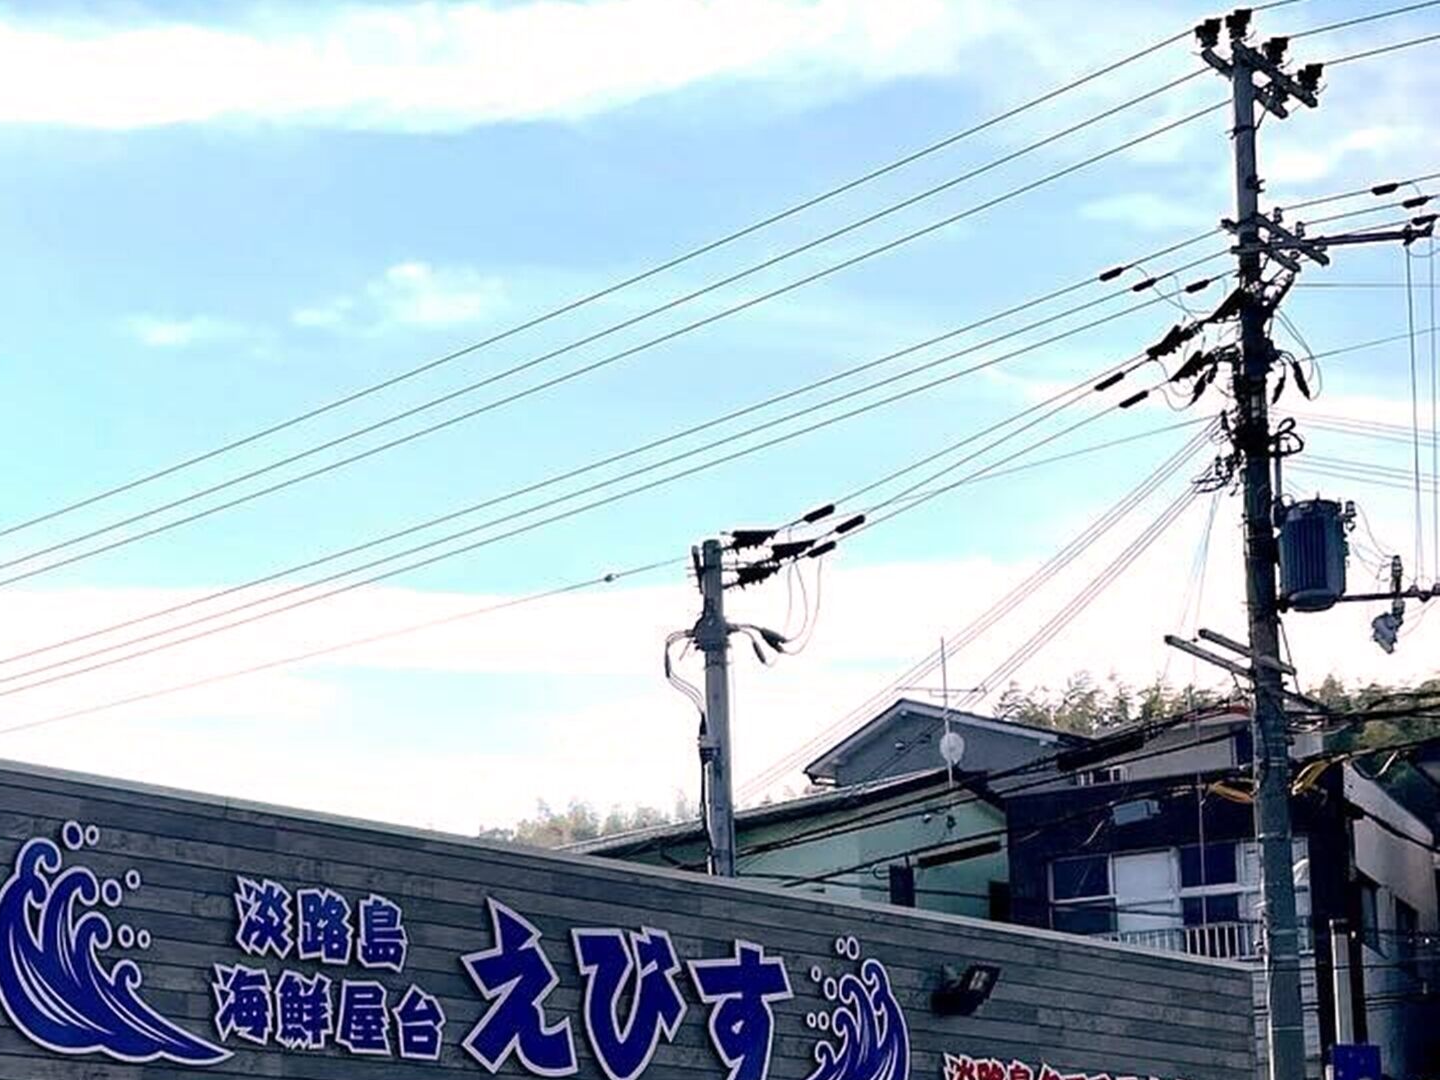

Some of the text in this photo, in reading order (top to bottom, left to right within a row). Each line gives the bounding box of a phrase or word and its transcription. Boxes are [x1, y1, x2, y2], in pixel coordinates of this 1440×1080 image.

[235, 875, 409, 972] 淡路島
[212, 963, 447, 1060] 海鮮屋台
